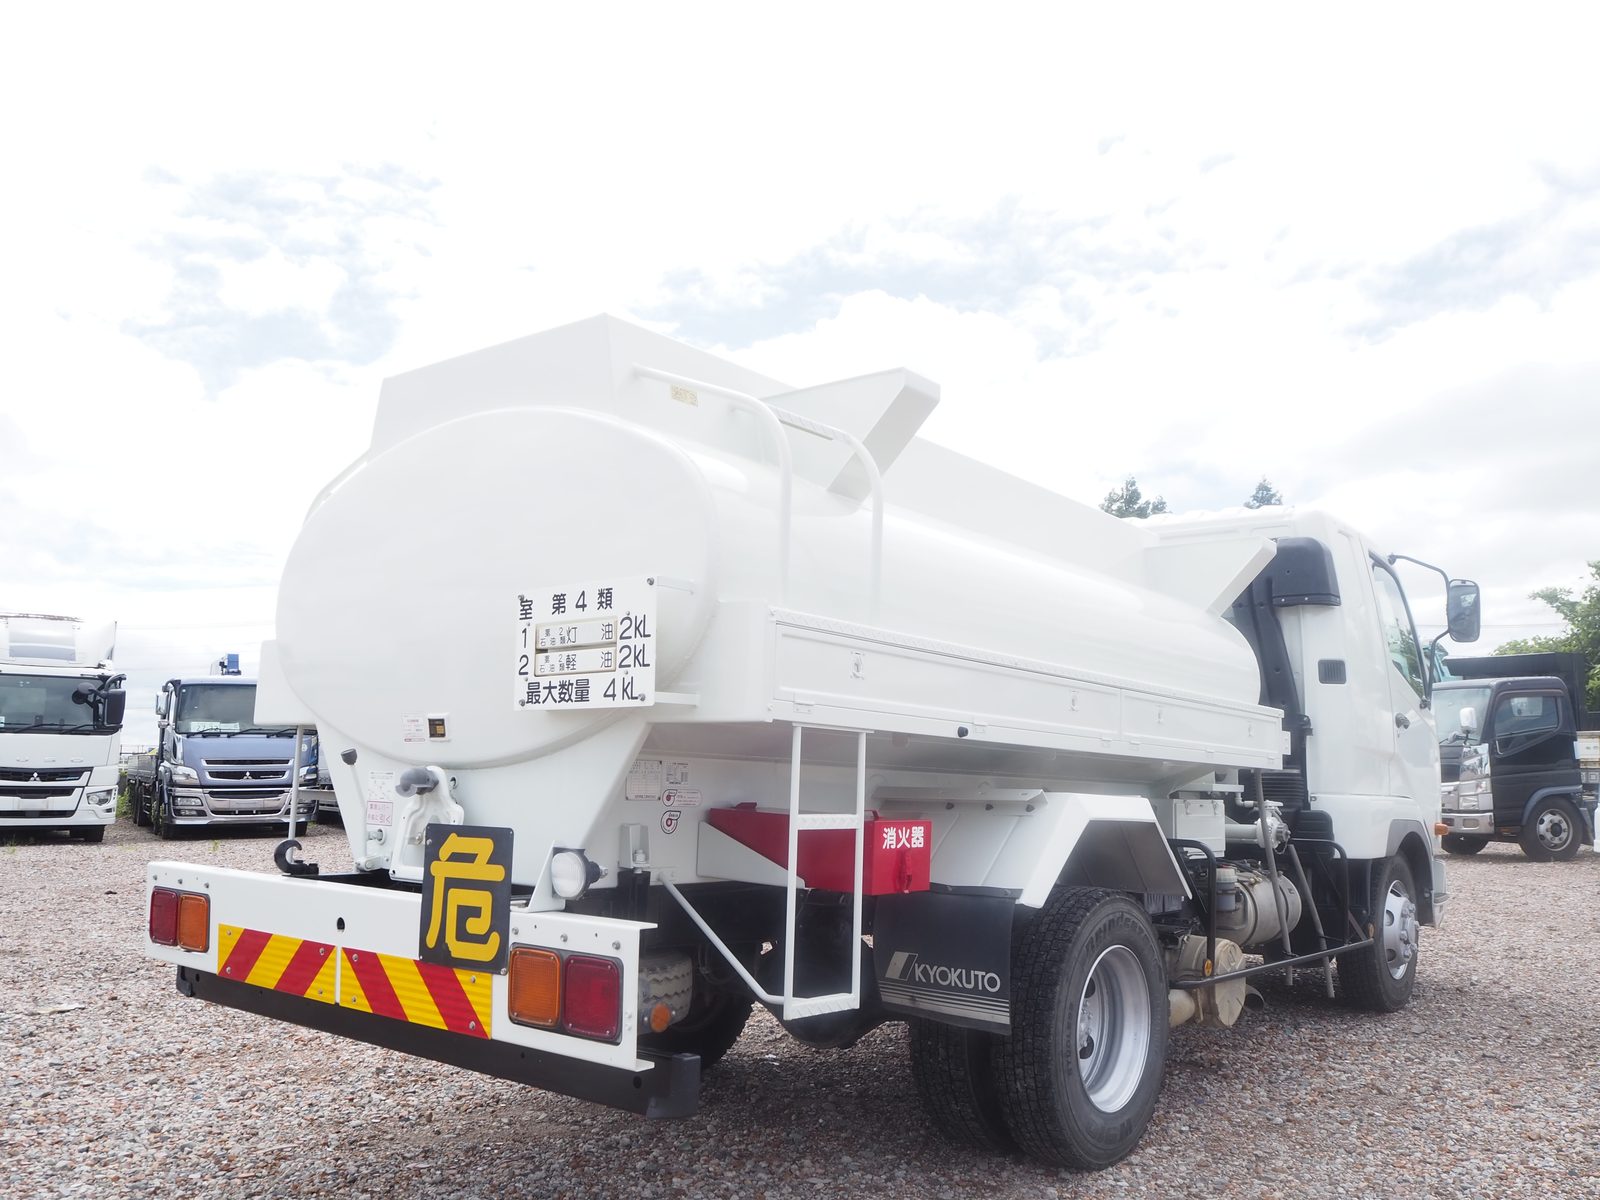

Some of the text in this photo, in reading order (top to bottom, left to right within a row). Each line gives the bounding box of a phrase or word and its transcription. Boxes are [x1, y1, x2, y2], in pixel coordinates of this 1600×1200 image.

[521, 628, 527, 648] 1
[519, 654, 529, 675] 2
[526, 679, 590, 704] 最大数量
[882, 826, 924, 849] 消火器
[426, 832, 505, 962] 危
[914, 962, 1001, 993] KYOKUTO
